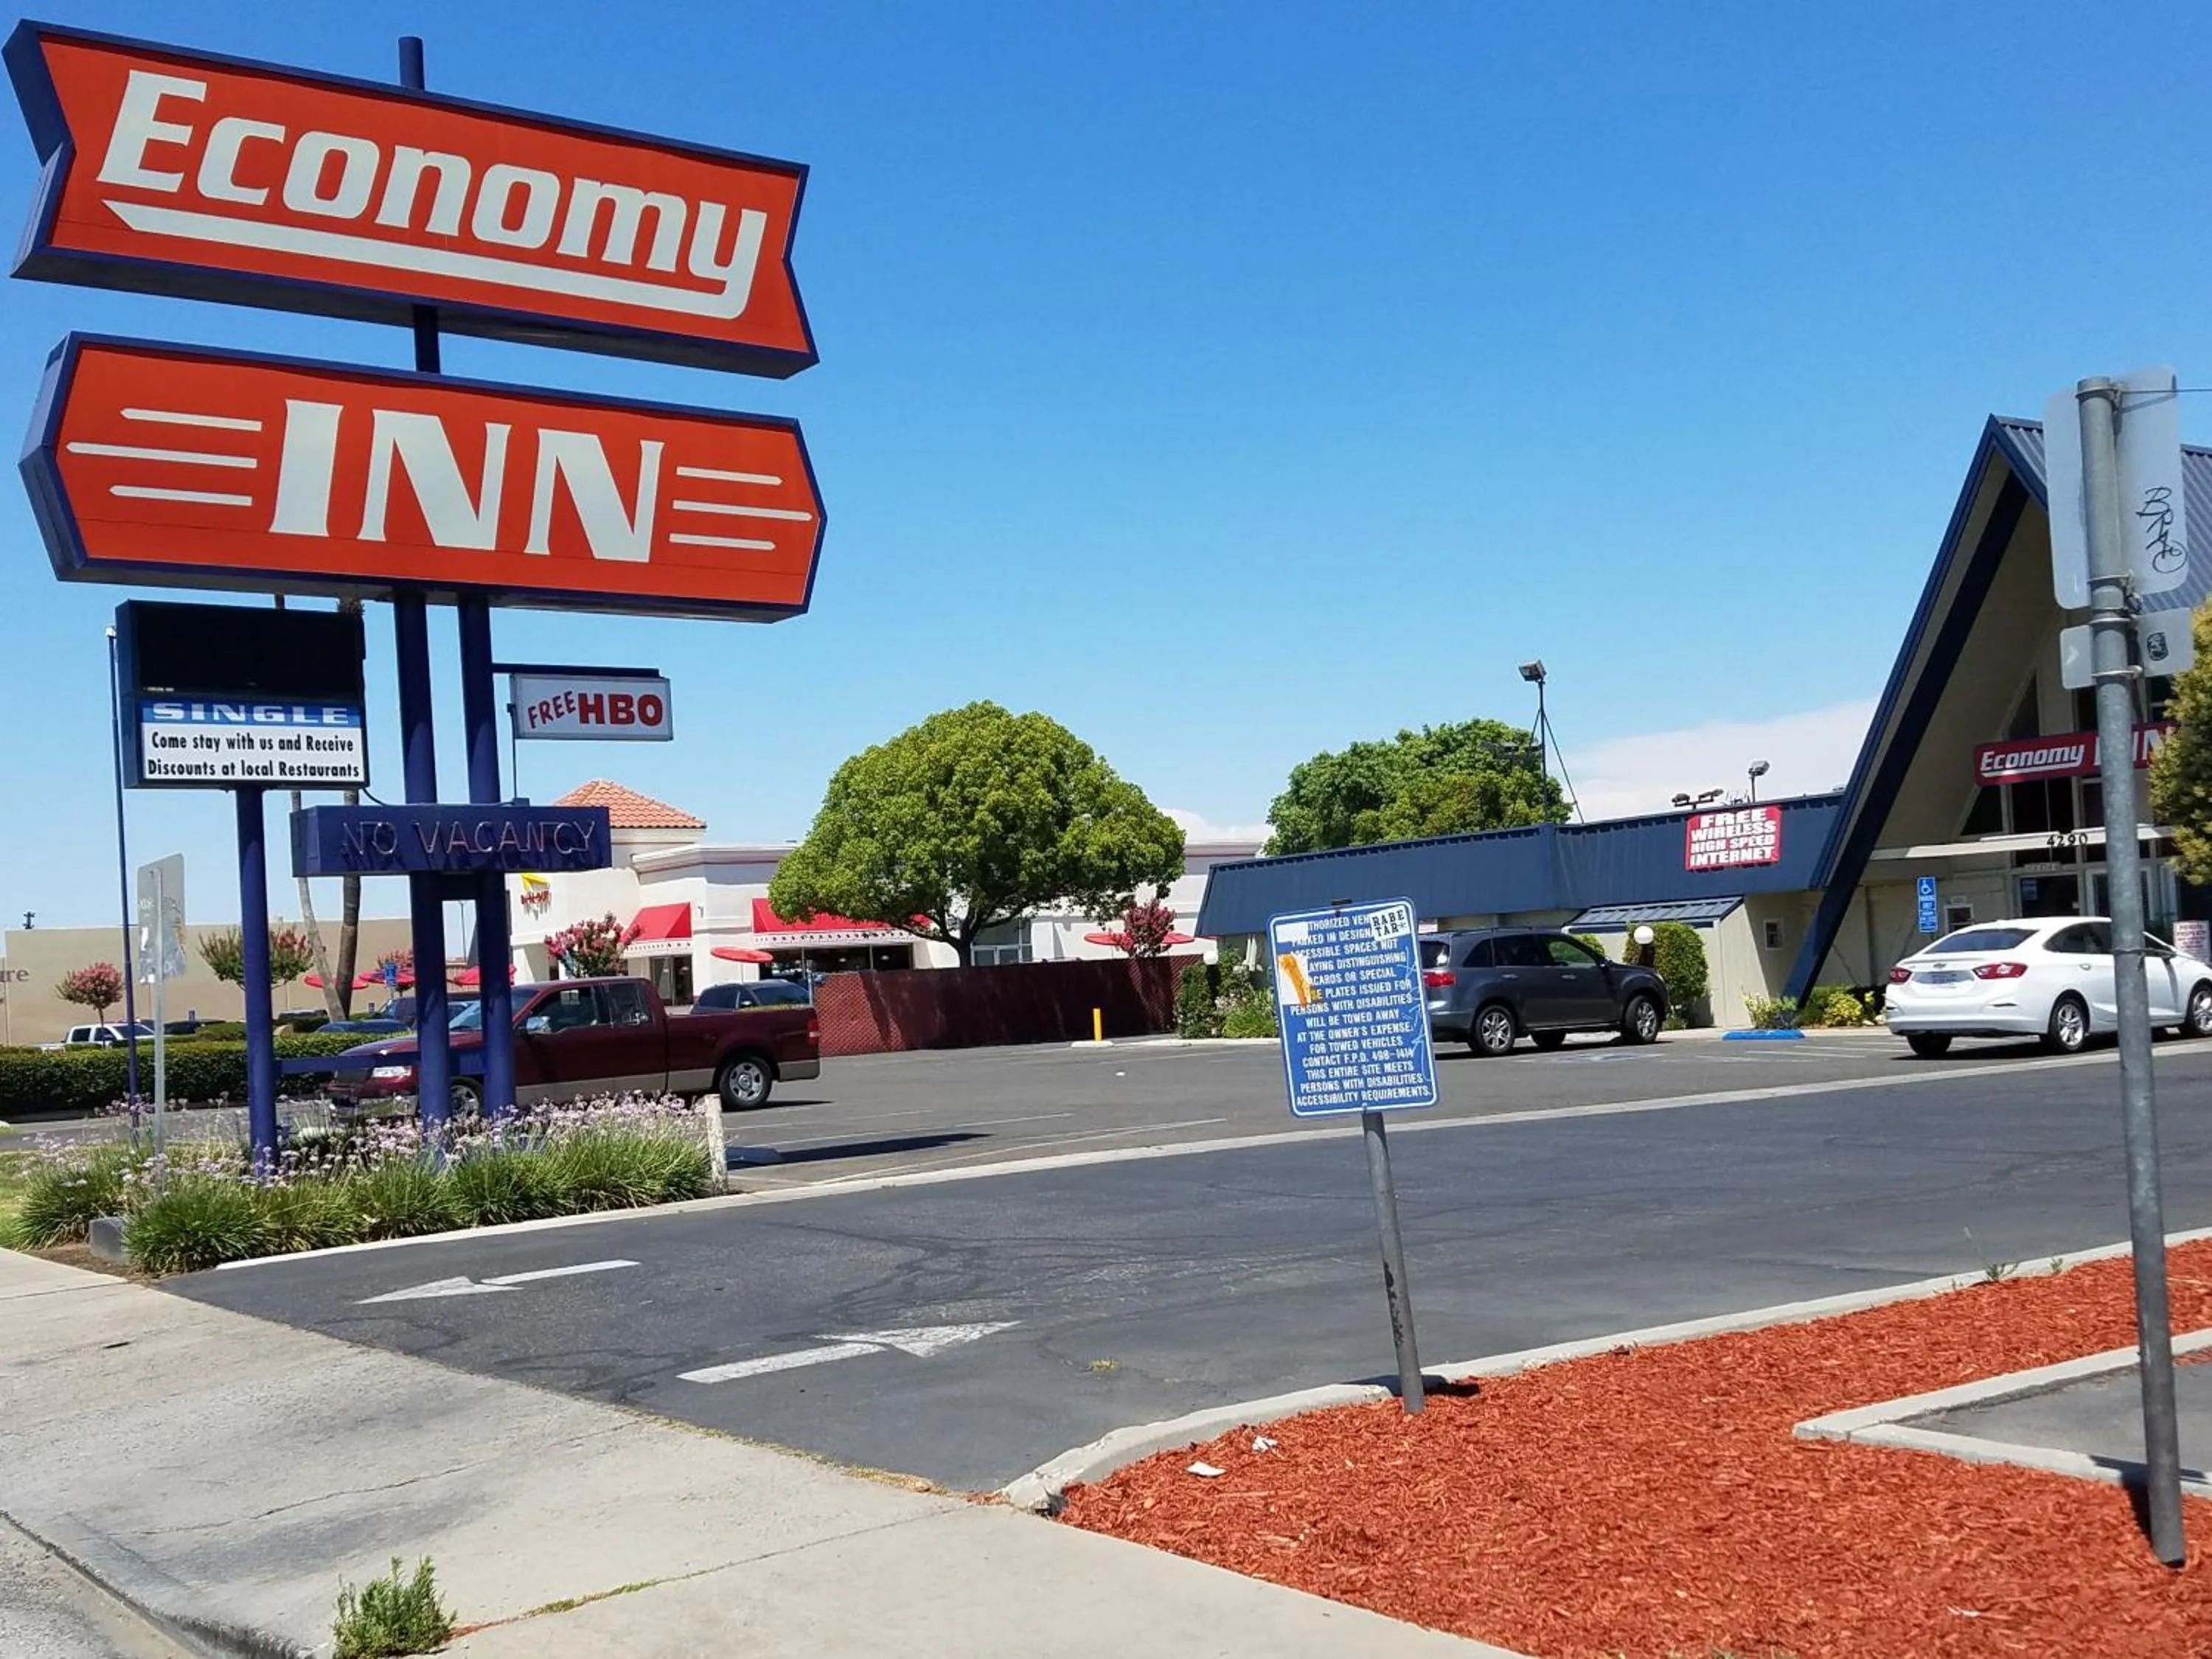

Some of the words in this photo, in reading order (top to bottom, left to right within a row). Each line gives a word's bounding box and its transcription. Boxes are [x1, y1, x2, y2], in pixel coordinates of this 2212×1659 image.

[96, 70, 768, 319] Economy
[268, 399, 664, 563] INN
[153, 703, 349, 724] SINGLE
[528, 691, 577, 728] FREE
[577, 693, 663, 726] HBO
[152, 731, 187, 749] Come
[193, 734, 220, 752] stay
[226, 733, 254, 750] with
[260, 738, 274, 751] us
[279, 734, 302, 751] and
[307, 734, 353, 751] Receive
[147, 759, 215, 776] Discounts
[222, 762, 235, 776] at
[241, 759, 273, 776] local
[279, 761, 359, 777] Restaurants
[1980, 745, 2085, 774] Economy
[1700, 808, 1767, 827] FREE
[343, 821, 397, 855] NO
[413, 820, 595, 855] VACANCY
[1691, 820, 1776, 841] WIRELESS
[2047, 833, 2088, 847] 4290
[1691, 838, 1726, 854] HIGH
[1729, 834, 1775, 849] SPEED
[1689, 846, 1774, 866] INTERNET
[1327, 931, 1338, 942] IN
[1344, 941, 1378, 954] SPACES
[1381, 939, 1398, 950] NOT
[1337, 952, 1406, 970] DISTINGUISHING
[1345, 971, 1357, 982] OR
[1360, 967, 1397, 980] SPECIAL
[1325, 985, 1357, 998] PLATES
[1360, 981, 1391, 993] ISSUED
[1394, 978, 1412, 990] FOR
[1290, 1002, 1329, 1015] PERSONS
[1332, 999, 1354, 1011] WITH
[1357, 993, 1412, 1009] DISABILITIES
[1306, 1017, 1326, 1029] WILL
[1329, 1015, 1340, 1026] BE
[1342, 1012, 1372, 1024] TOWED
[1375, 1009, 1399, 1020] AWAY
[1298, 1032, 1307, 1043] AT
[1310, 1030, 1325, 1041] THE
[1328, 1027, 1368, 1040] OWNER'S
[1371, 1022, 1413, 1036] EXPENSE.
[1310, 1043, 1326, 1054] FOR
[1329, 1040, 1358, 1052] TOWED
[1361, 1036, 1403, 1049] VEHICLES
[1302, 1054, 1340, 1068] CONTACT
[1306, 1069, 1326, 1081] THIS
[1329, 1065, 1358, 1078] ENTIRE
[1362, 1063, 1381, 1074] SITE
[1384, 1060, 1414, 1072] MEETS
[1300, 1081, 1340, 1093] PERSONS
[1343, 1078, 1364, 1089] WITH
[1367, 1073, 1423, 1088] DISABILITIES
[1297, 1092, 1359, 1107] ACCESSIBILITY
